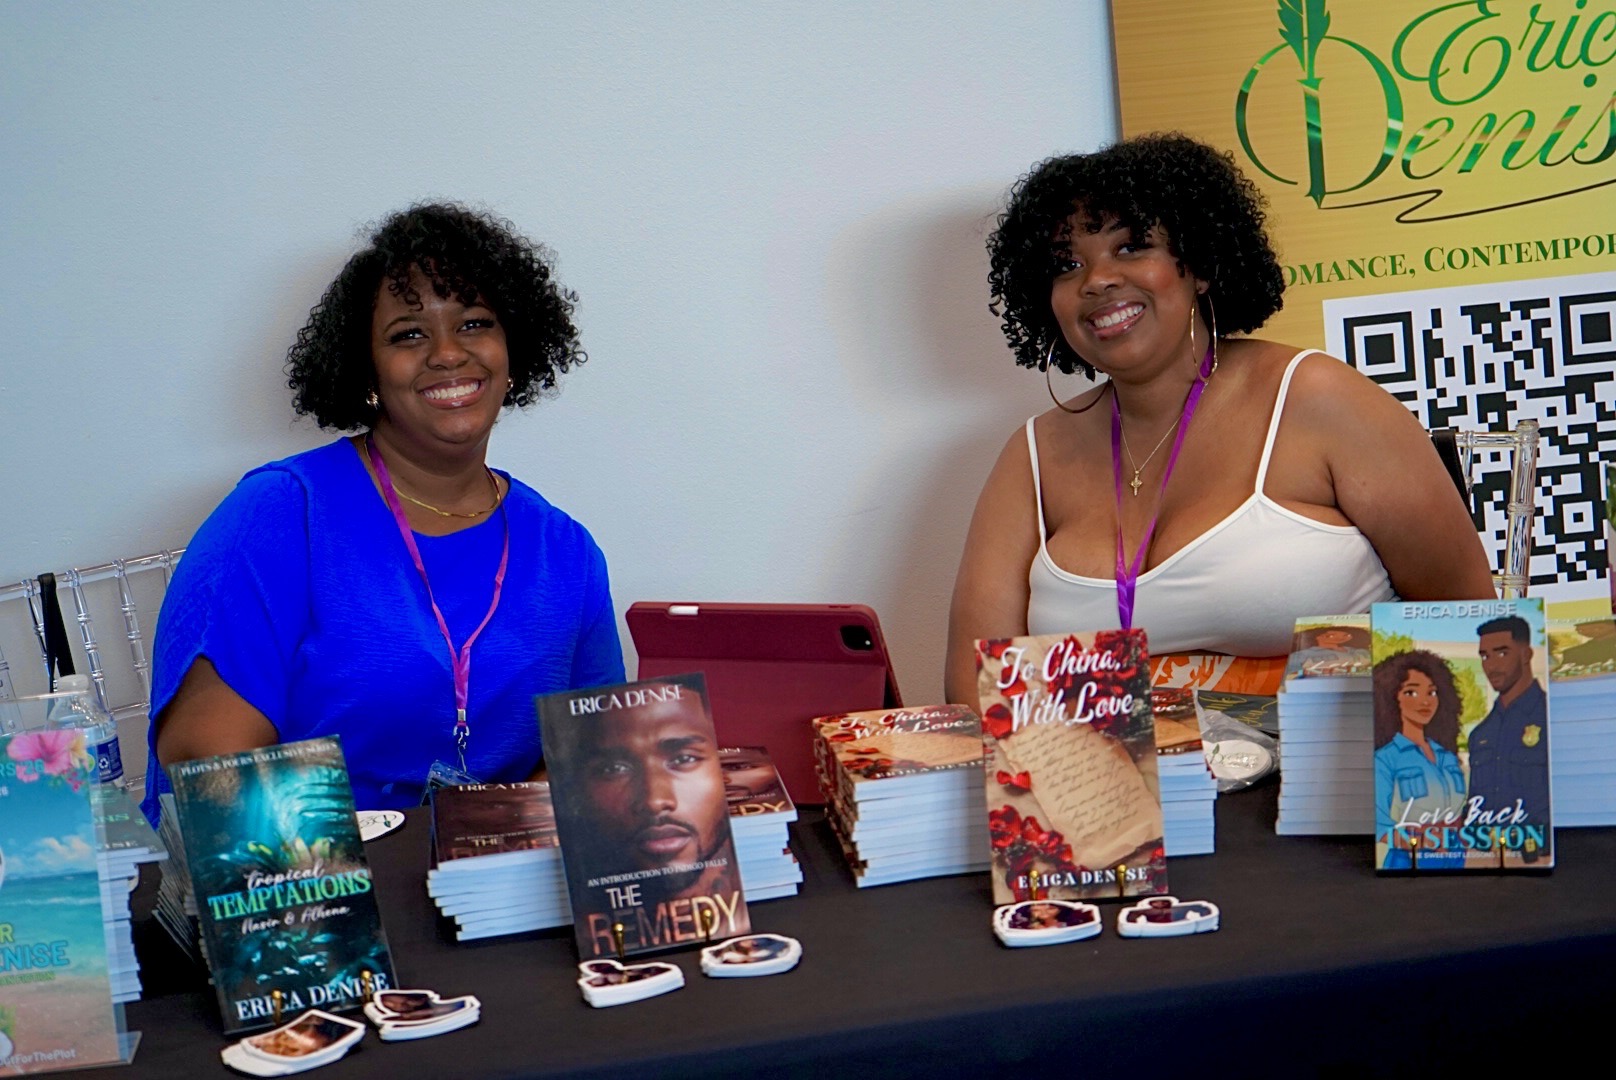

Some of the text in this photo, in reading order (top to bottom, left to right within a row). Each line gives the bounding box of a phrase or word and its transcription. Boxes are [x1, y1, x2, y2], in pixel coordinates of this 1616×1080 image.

[1281, 253, 1416, 288] OMANCE,
[1403, 602, 1518, 619] ERICA DENISE
[997, 641, 1121, 689] To China,
[569, 684, 685, 716] ERICA DENISE
[1010, 681, 1134, 733] With Love
[1394, 795, 1529, 829] Love Back
[1424, 824, 1545, 851] SESSION
[243, 857, 325, 890] tropical
[587, 857, 728, 888] AN INTRODUCTION TO INDIGO FALLS
[1081, 866, 1148, 883] DENSE
[207, 868, 371, 921] TEMPTATIONS
[605, 883, 643, 909] THE
[284, 911, 295, 926] &
[588, 890, 740, 956] REMEDY
[0, 940, 70, 972] NISE
